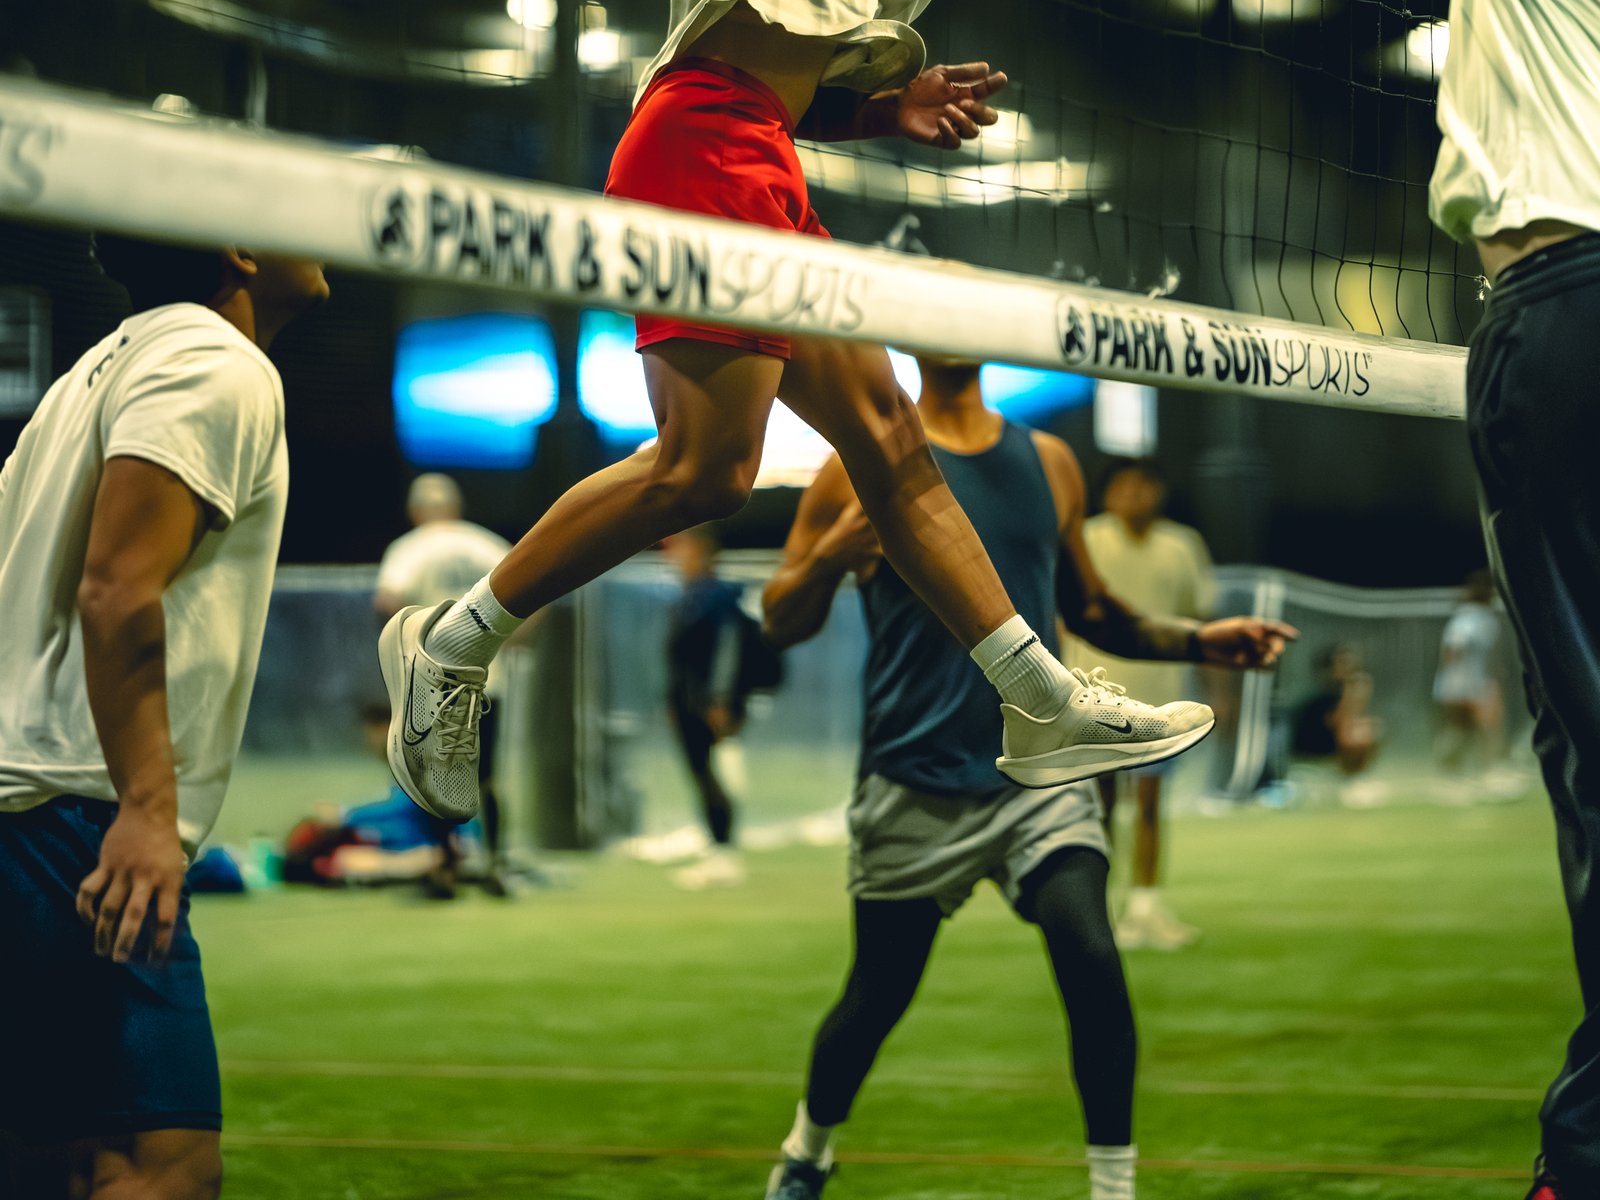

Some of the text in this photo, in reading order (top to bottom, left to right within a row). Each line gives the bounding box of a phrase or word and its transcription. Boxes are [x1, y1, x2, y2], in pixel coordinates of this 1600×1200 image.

[425, 191, 556, 291] PARK
[573, 218, 602, 294] &
[1090, 303, 1175, 374] PARK
[1181, 317, 1204, 377] &
